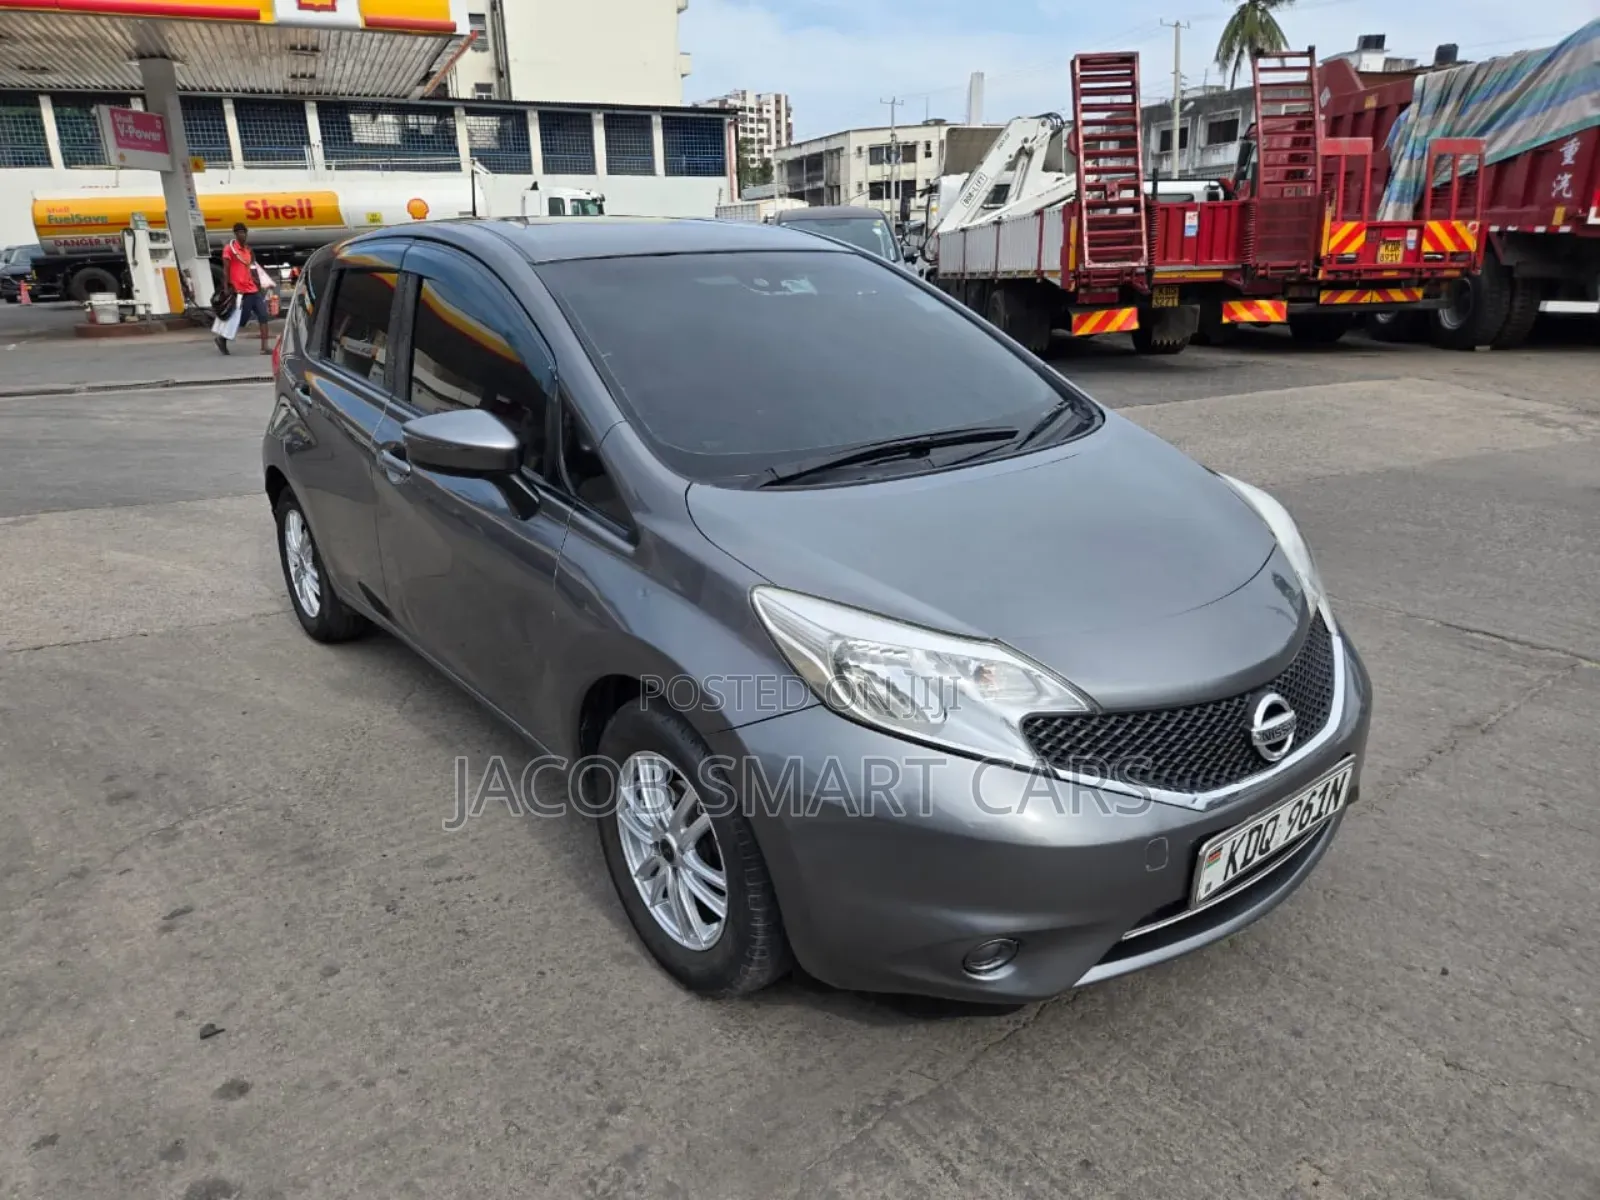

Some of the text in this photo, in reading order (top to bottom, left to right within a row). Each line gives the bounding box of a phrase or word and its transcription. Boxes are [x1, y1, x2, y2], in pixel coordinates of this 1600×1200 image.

[116, 122, 162, 141] V-Power
[1551, 137, 1581, 198] 重汽
[47, 212, 108, 225] FuelSave
[244, 198, 314, 220] Shell
[54, 237, 101, 247] DANGER
[1223, 771, 1348, 881] KDQ 961N
